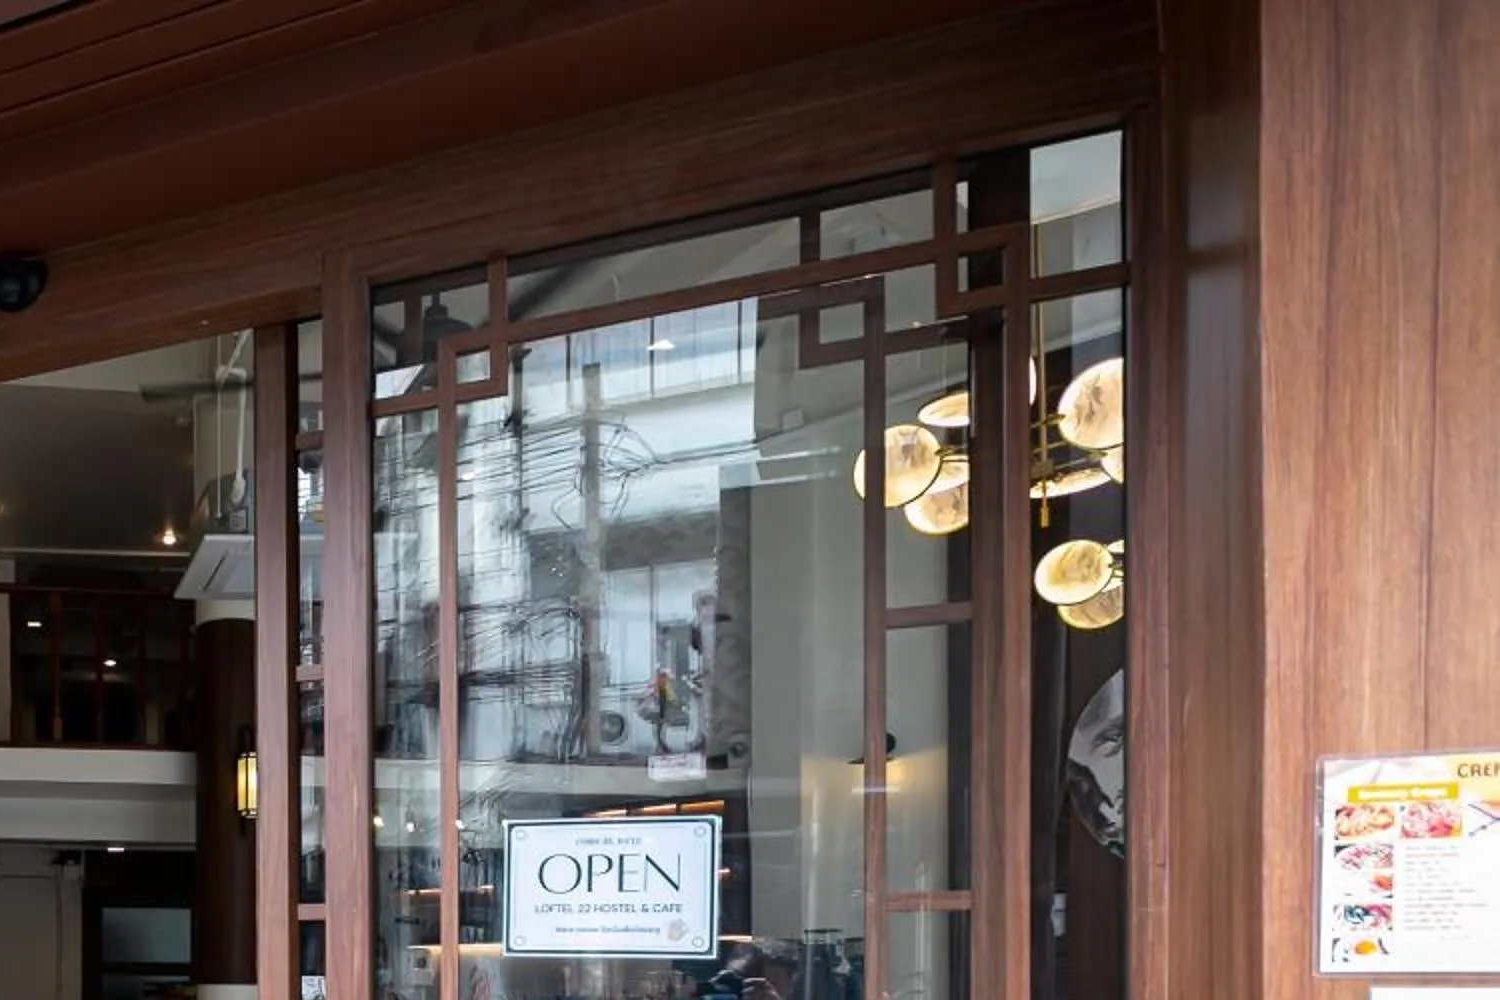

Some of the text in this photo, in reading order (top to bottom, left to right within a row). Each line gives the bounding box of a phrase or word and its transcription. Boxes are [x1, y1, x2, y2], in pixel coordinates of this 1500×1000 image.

[538, 853, 681, 895] OPEN
[534, 903, 573, 914] LOFTEL
[578, 903, 591, 914] 22
[594, 903, 636, 913] HOSTEL
[641, 903, 649, 913] &
